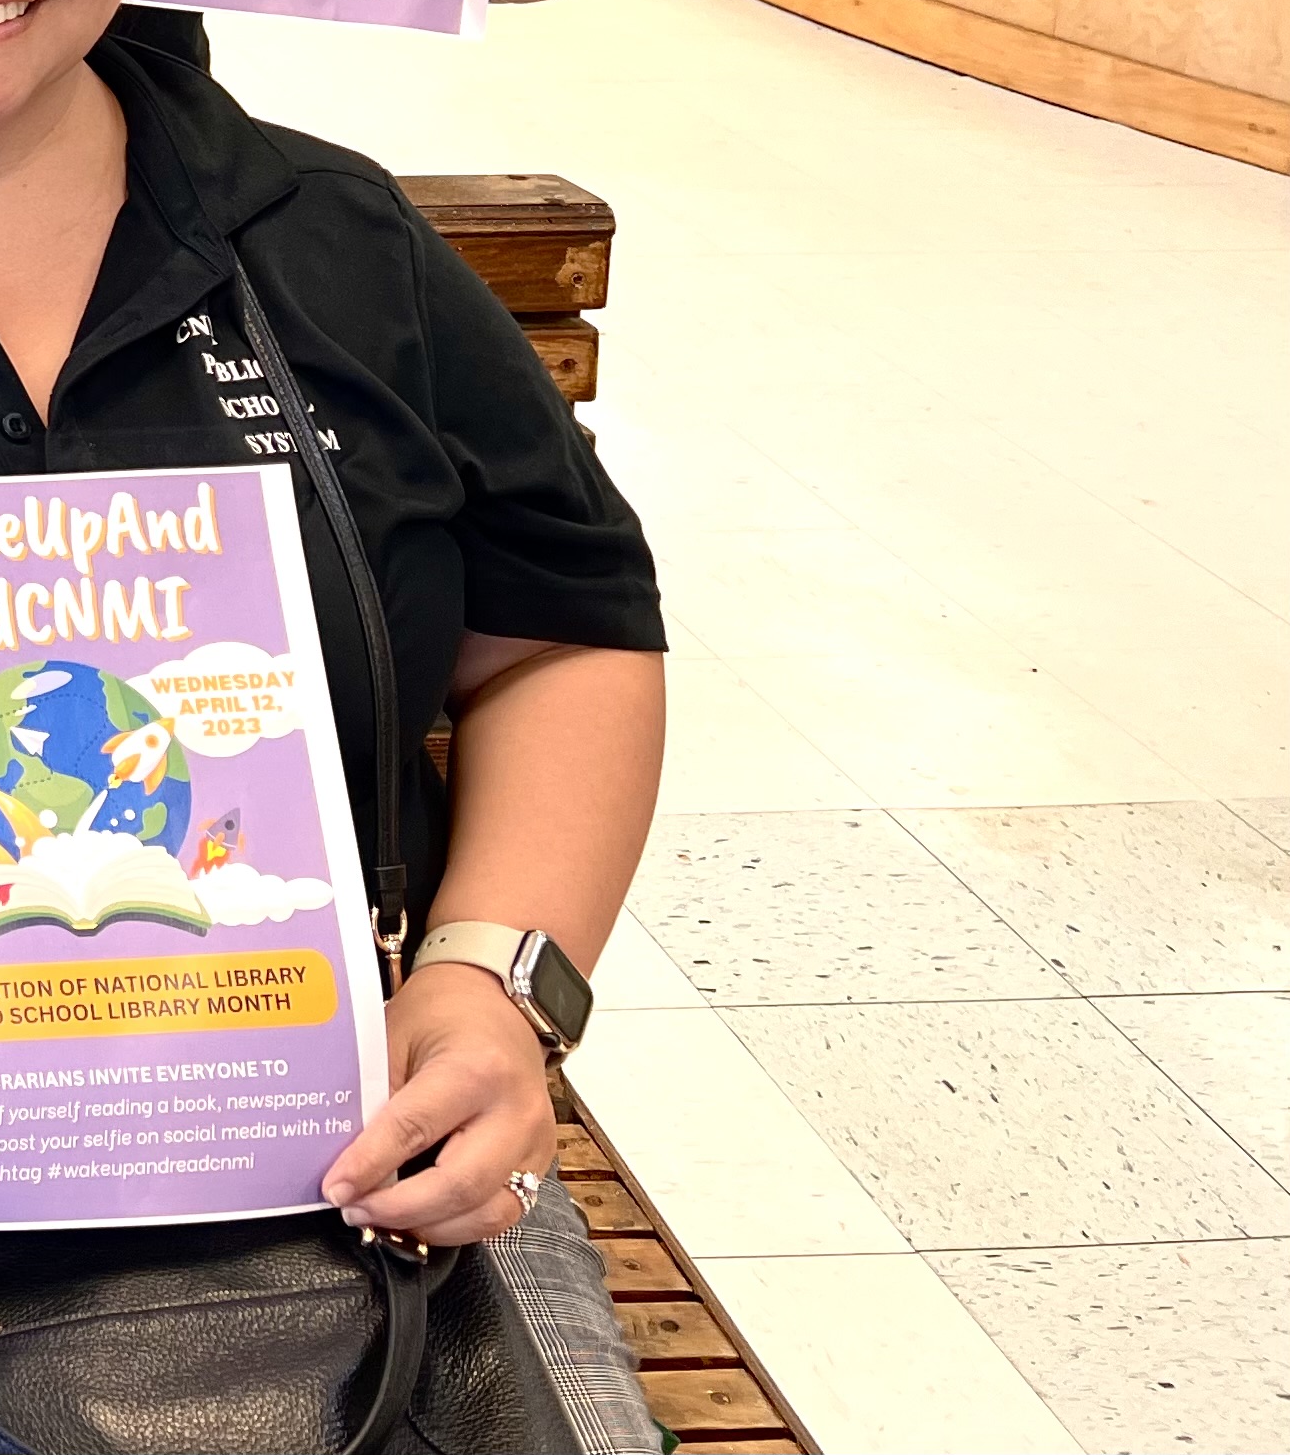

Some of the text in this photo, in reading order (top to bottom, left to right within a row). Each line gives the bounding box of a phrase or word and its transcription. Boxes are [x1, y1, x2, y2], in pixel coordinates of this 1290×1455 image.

[151, 670, 296, 694] WEDNESDAY
[179, 694, 282, 715] APRIL 12,
[202, 717, 262, 737] 2023
[59, 978, 87, 996] OF
[93, 971, 208, 994] NATIONAL
[214, 965, 305, 987] LIBRARY
[10, 1003, 102, 1024] SCHOOL
[107, 998, 199, 1019] LIBRARY
[206, 992, 290, 1014] MONTH
[89, 1066, 152, 1085] INVITE
[155, 1060, 258, 1081] EVERYONE
[260, 1059, 288, 1076] TO
[8, 1100, 80, 1125] yourself
[84, 1098, 152, 1118] reading
[157, 1100, 168, 1113] a
[173, 1093, 221, 1112] book,
[226, 1091, 330, 1111] newspaper,
[334, 1089, 352, 1103] or
[39, 1135, 79, 1153] your
[83, 1128, 131, 1151] selfie
[136, 1131, 158, 1144] on
[163, 1123, 216, 1143] social
[221, 1121, 277, 1140] media
[281, 1118, 319, 1136] with
[324, 1117, 351, 1134] the
[47, 1151, 254, 1179] #wakeupandreadcnmi
